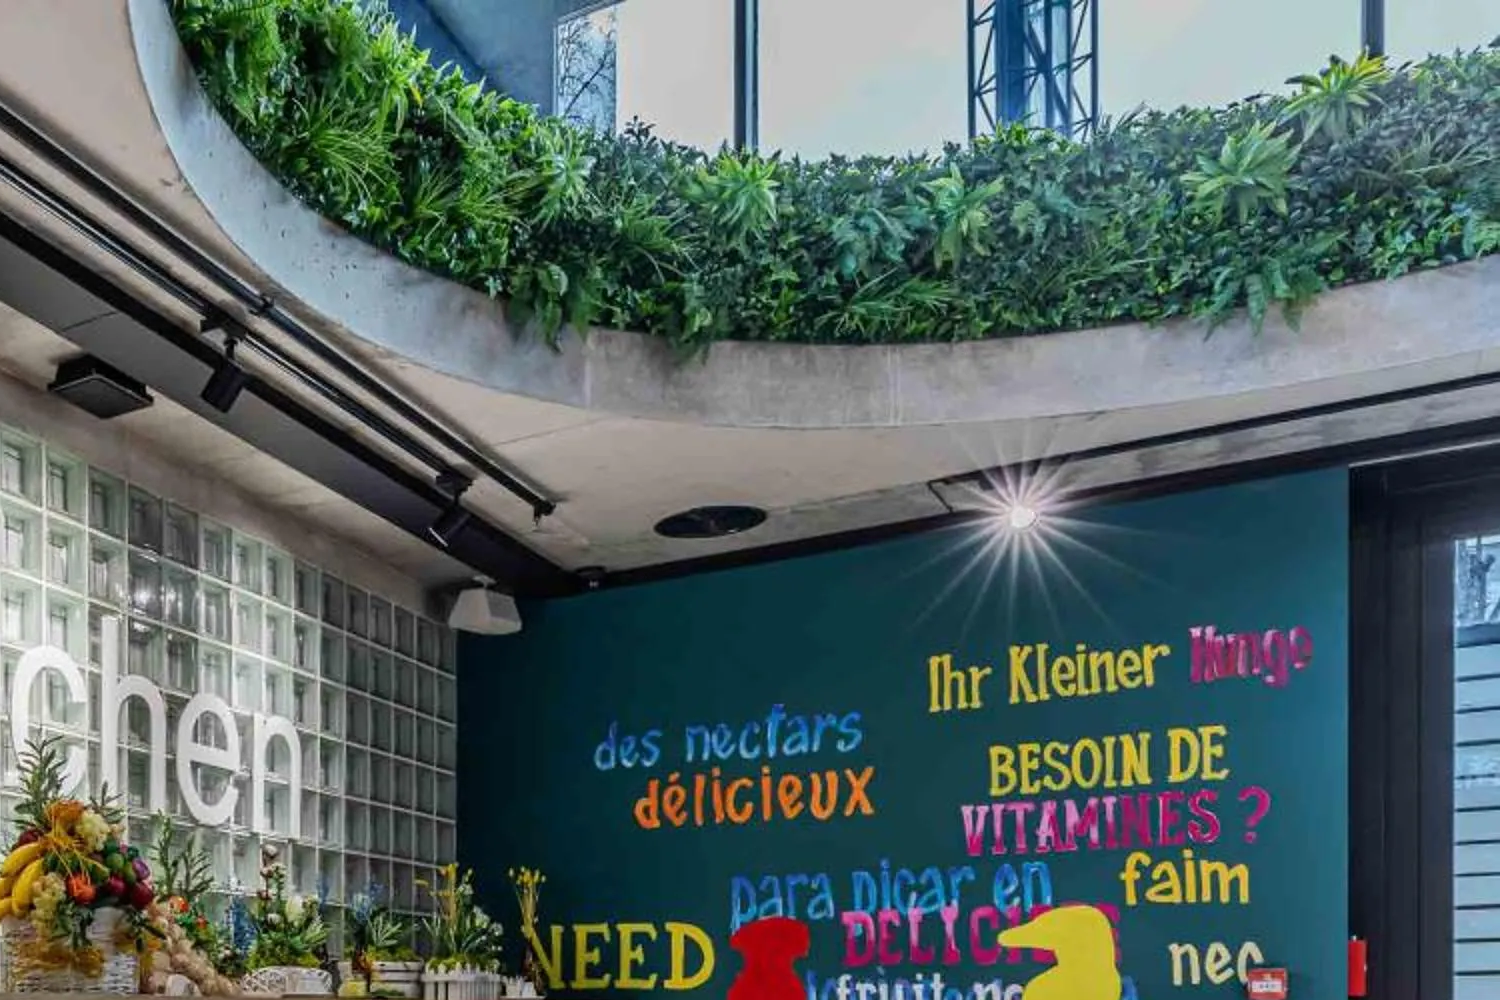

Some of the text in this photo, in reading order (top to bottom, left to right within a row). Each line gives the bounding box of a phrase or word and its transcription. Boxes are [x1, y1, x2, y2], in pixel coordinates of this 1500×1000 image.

[928, 653, 992, 713] Ihr
[1008, 642, 1171, 704] Kleiner
[594, 703, 865, 771] des nectars
[988, 724, 1231, 797] BESOIN DE
[633, 765, 876, 830] délicieux
[960, 788, 1222, 857] VITAMINES
[729, 872, 835, 936] para
[994, 861, 1052, 914] en
[1119, 848, 1250, 906] faim
